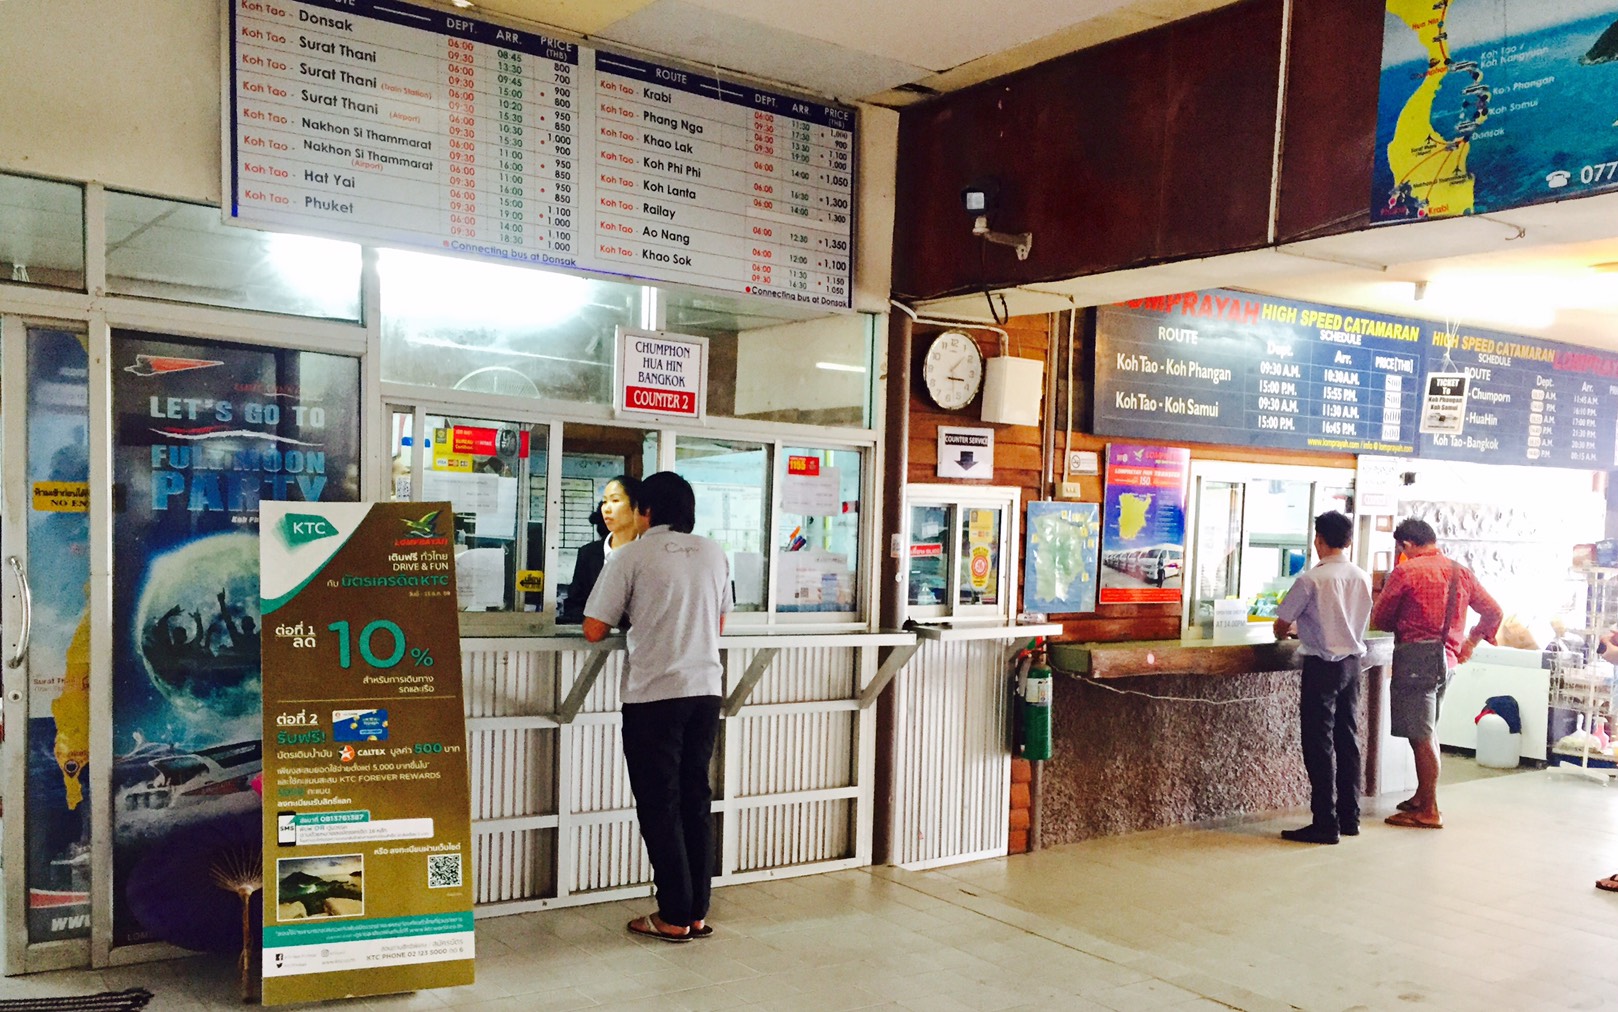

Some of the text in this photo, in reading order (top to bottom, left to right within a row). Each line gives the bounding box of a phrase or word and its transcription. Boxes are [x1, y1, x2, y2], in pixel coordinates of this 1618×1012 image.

[241, 0, 352, 31] Koh Tao Donsak
[299, 36, 376, 62] Surat Thani
[541, 37, 572, 52] PRICE
[300, 63, 336, 80] Surat
[340, 71, 376, 88] Thani
[656, 68, 687, 84] ROUTE
[301, 90, 337, 106] Surat
[341, 97, 378, 114] Thani
[644, 88, 671, 103] Krabi
[644, 111, 703, 134] Phang Nga
[824, 108, 848, 120] PRICE
[302, 118, 432, 150] Nakhon Si Thammarat
[644, 134, 693, 154] Khao Lak
[304, 140, 433, 170] Nakhon Si Thammarat
[644, 157, 700, 178] Koh Phi Phi
[1581, 161, 1618, 184] 077
[305, 170, 355, 188] Hat Yai
[644, 180, 696, 199] Koh Lanta
[245, 190, 353, 213] Koh Tao Phuket
[644, 203, 675, 220] Railay
[643, 226, 689, 245] Ao Nang
[451, 241, 576, 266] Connecting bus at Donsak
[643, 249, 692, 266] Khao Sok
[752, 286, 795, 300] Connecting
[797, 293, 810, 302] bus
[821, 297, 847, 308] Donsak
[1262, 303, 1420, 342] HIGH SPEED CATAMARAN
[1159, 326, 1198, 344] ROUTE
[1320, 329, 1362, 345] SCHEDULE
[635, 341, 690, 358] CHUMPHON
[1432, 331, 1556, 362] HIGH SPEED CATAMARAN
[643, 357, 682, 372] HUA HIN
[1335, 350, 1352, 365] Arr.
[1479, 353, 1511, 366] SCHEDULE
[1117, 353, 1231, 384] Koh Tao Koh Phangan
[1261, 362, 1300, 378] 09:30 A.M.
[638, 371, 685, 387] BANGKOK
[1437, 379, 1459, 387] TICKET
[1537, 375, 1593, 393] Dept. Arr.
[1259, 380, 1297, 396] 15:00 P.M.
[1324, 387, 1357, 402] 15:55 P.M.
[1472, 387, 1511, 404] Chumporn
[634, 390, 688, 410] COUNTER 2
[1116, 391, 1218, 417] Koh Tao Koh Samui
[1258, 398, 1299, 413] 09:30 A.M.
[244, 402, 280, 425] GO
[292, 406, 325, 428] TO
[1323, 404, 1359, 419] 11:30 A.M.
[1470, 412, 1497, 426] HuaHin
[1258, 415, 1295, 430] 15:00 P.M.
[1322, 421, 1356, 436] 16:45 P.M.
[945, 435, 988, 445] COUNTER SERVICE
[1433, 433, 1448, 447] Koh
[151, 470, 327, 512] PARTY
[293, 522, 326, 535] KTC
[393, 563, 419, 571] DRIVE
[430, 563, 448, 571] FUN
[421, 575, 448, 586] KTC
[275, 621, 316, 636] ต่อที่ 1
[293, 637, 316, 648] ลด
[327, 619, 434, 669] 10 %
[276, 709, 318, 726] ต่อที่ 2
[415, 743, 443, 754] 500
[339, 772, 441, 783] KTC FOREVER REWARDS
